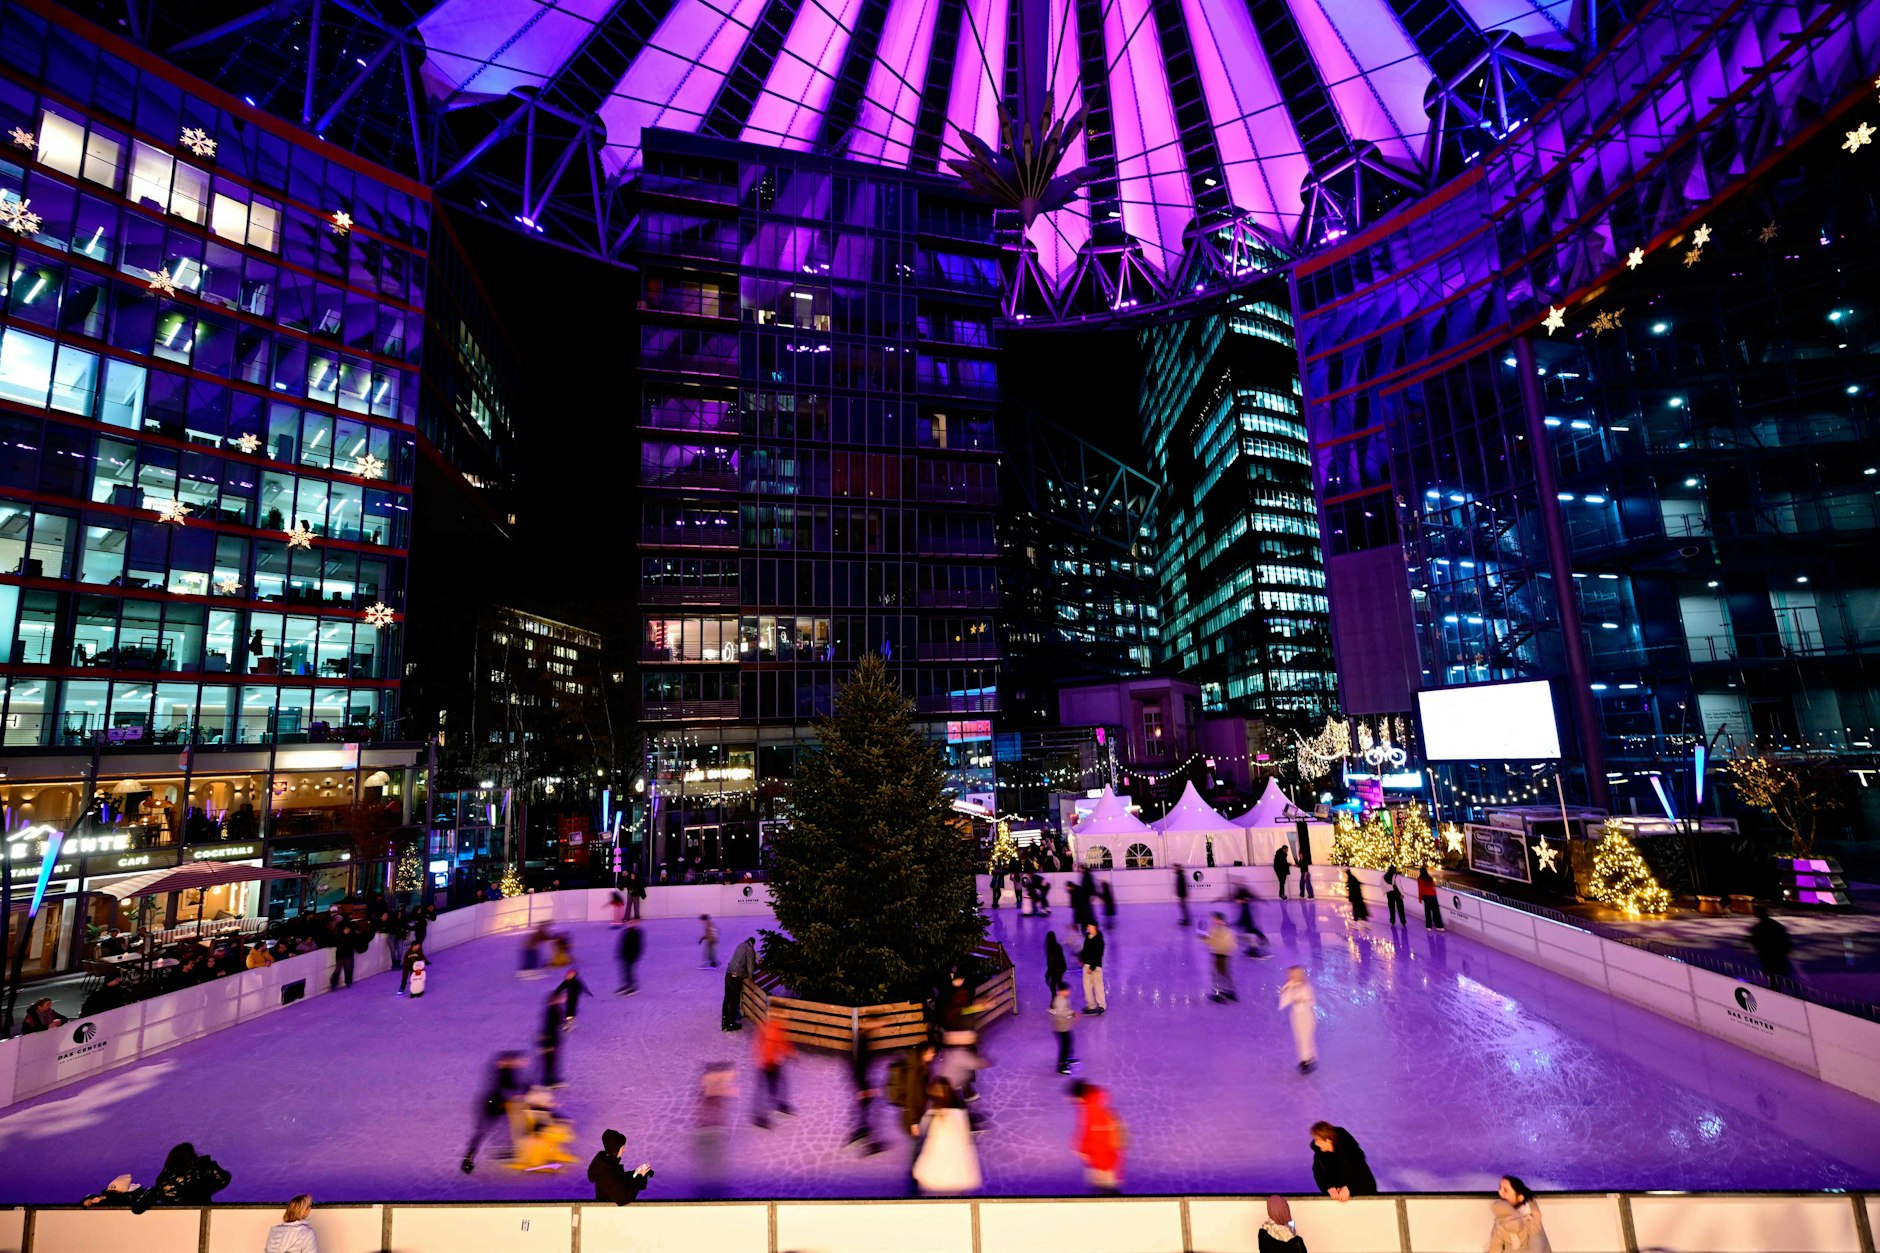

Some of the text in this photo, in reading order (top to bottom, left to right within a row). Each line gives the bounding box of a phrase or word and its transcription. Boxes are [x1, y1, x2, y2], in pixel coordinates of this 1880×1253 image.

[194, 846, 254, 859] COCKTAILS
[118, 855, 149, 867] CAFÉ
[1727, 1009, 1742, 1019] DAS
[1744, 1015, 1774, 1031] CENTER
[57, 1052, 74, 1061] DAS
[76, 1041, 107, 1054] CENTER
